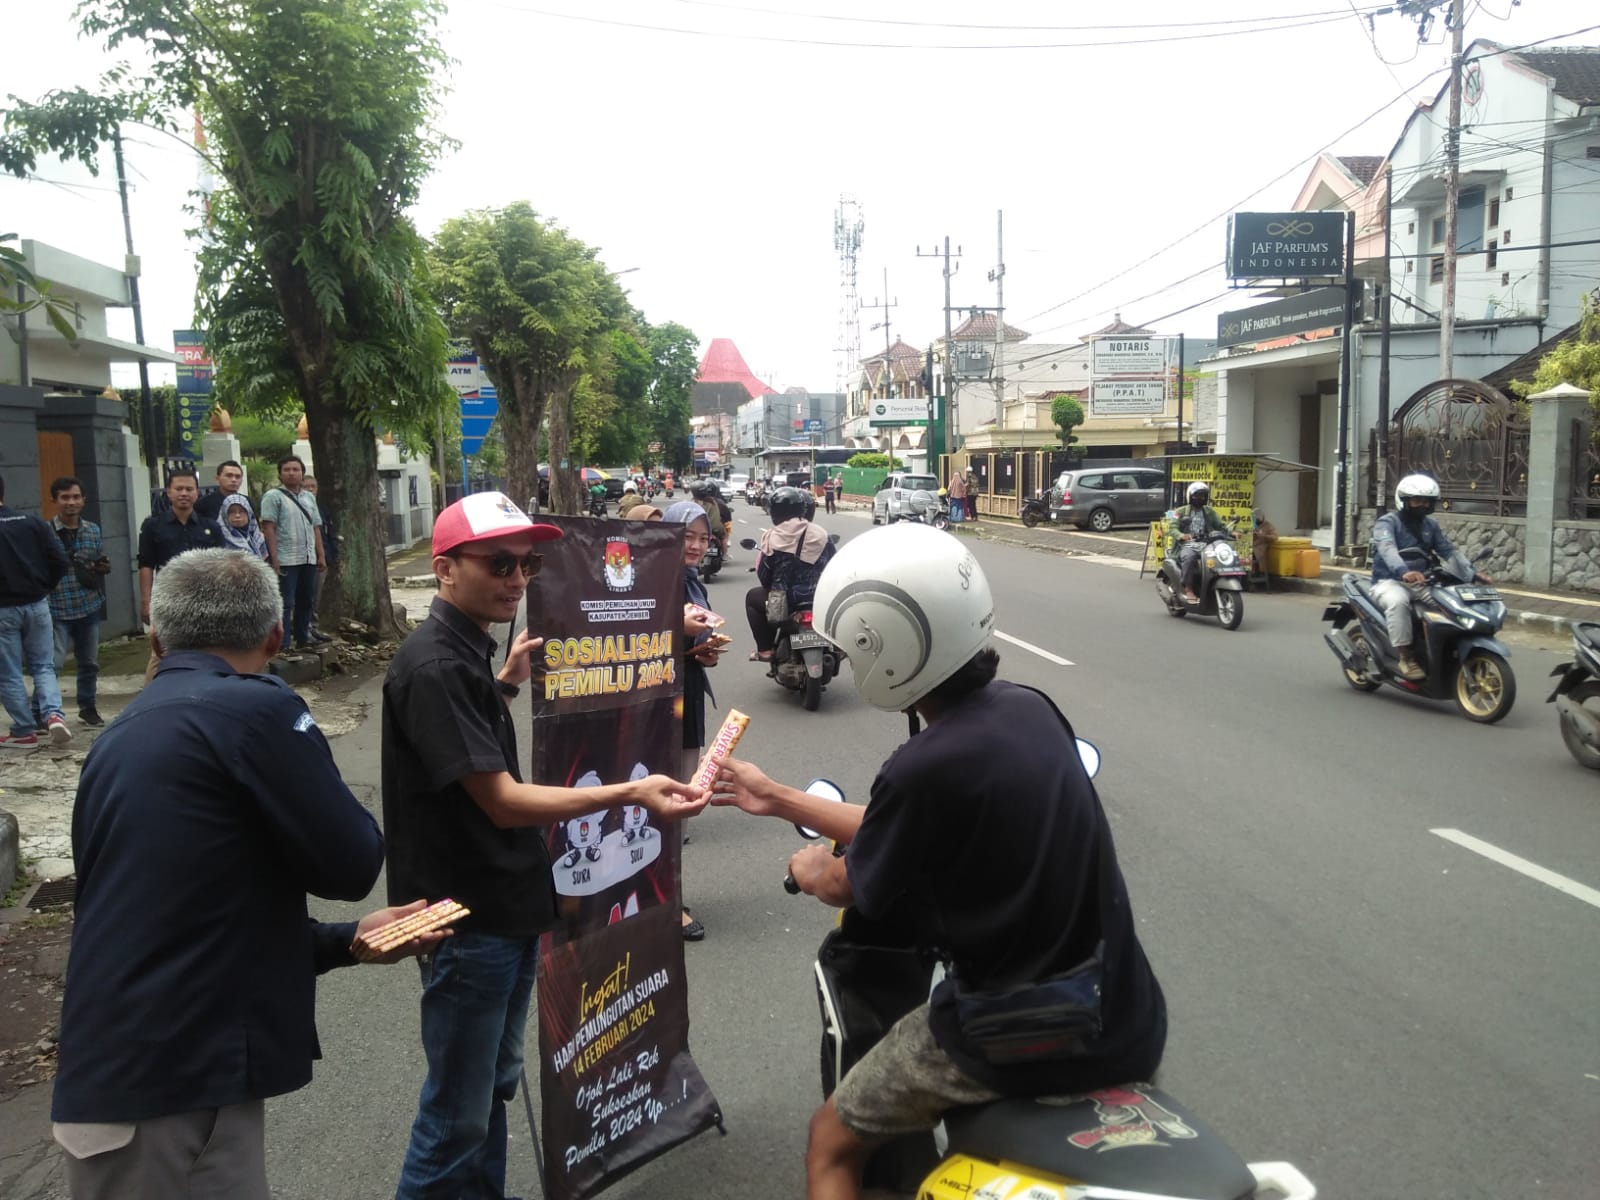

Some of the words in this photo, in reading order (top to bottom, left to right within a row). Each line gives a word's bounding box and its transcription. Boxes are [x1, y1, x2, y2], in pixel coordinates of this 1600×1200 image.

[1240, 258, 1338, 267] INDONESIA
[1251, 242, 1272, 256] JAF
[1241, 319, 1253, 335] JAF
[1109, 342, 1150, 351] NOTARIS
[1212, 500, 1253, 508] KRISTAL
[588, 611, 626, 622] KABUPATEN
[627, 610, 650, 620] JEMBER
[605, 600, 639, 610] PEMILIHAN
[544, 630, 673, 667] SOSIALISASI
[544, 665, 635, 700] PEMILU
[637, 658, 676, 689] 2024
[714, 723, 740, 757] SILVER
[697, 757, 719, 791] UEEN
[631, 847, 644, 864] SULU
[572, 868, 591, 885] SURA
[580, 951, 631, 1026] Ingat!
[553, 1037, 576, 1073] HARI
[575, 990, 635, 1052] PEMUNGUTAN
[634, 968, 669, 1003] SUARA
[572, 1054, 585, 1079] 14
[583, 1019, 630, 1069] FEBRUARI
[629, 999, 656, 1032] 2024
[606, 1061, 634, 1092] Lali
[591, 1081, 652, 1128] Sukseskan
[565, 1130, 606, 1174] Pemilu
[609, 1103, 643, 1141] 2024
